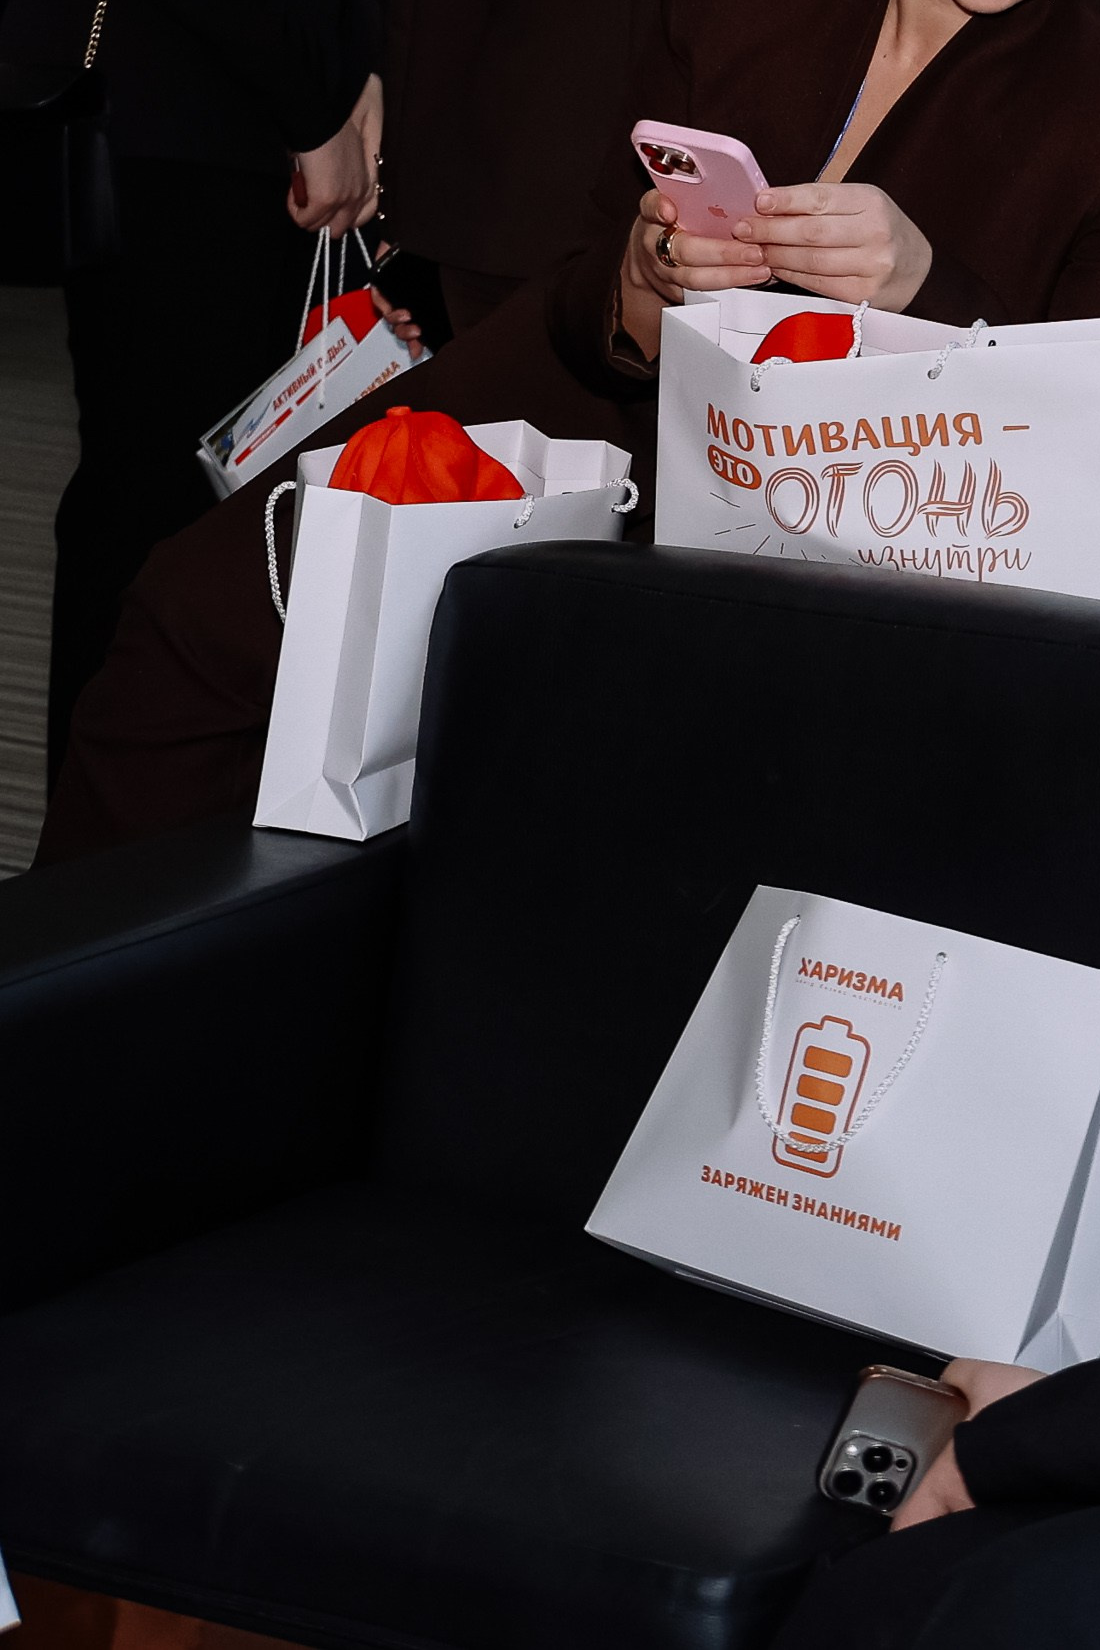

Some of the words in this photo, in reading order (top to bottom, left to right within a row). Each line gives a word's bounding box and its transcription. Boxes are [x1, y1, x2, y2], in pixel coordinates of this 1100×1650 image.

[707, 402, 982, 457] МОТИВАЦИЯ
[711, 447, 754, 487] ЭТО
[765, 458, 1030, 539] ОГОНЬ
[857, 544, 1032, 582] изнутри
[798, 957, 905, 1003] ХАРИЗМА
[701, 1165, 790, 1209] ЗАРЯЖЕН
[792, 1193, 902, 1242] ЗНАНИЯМИ
